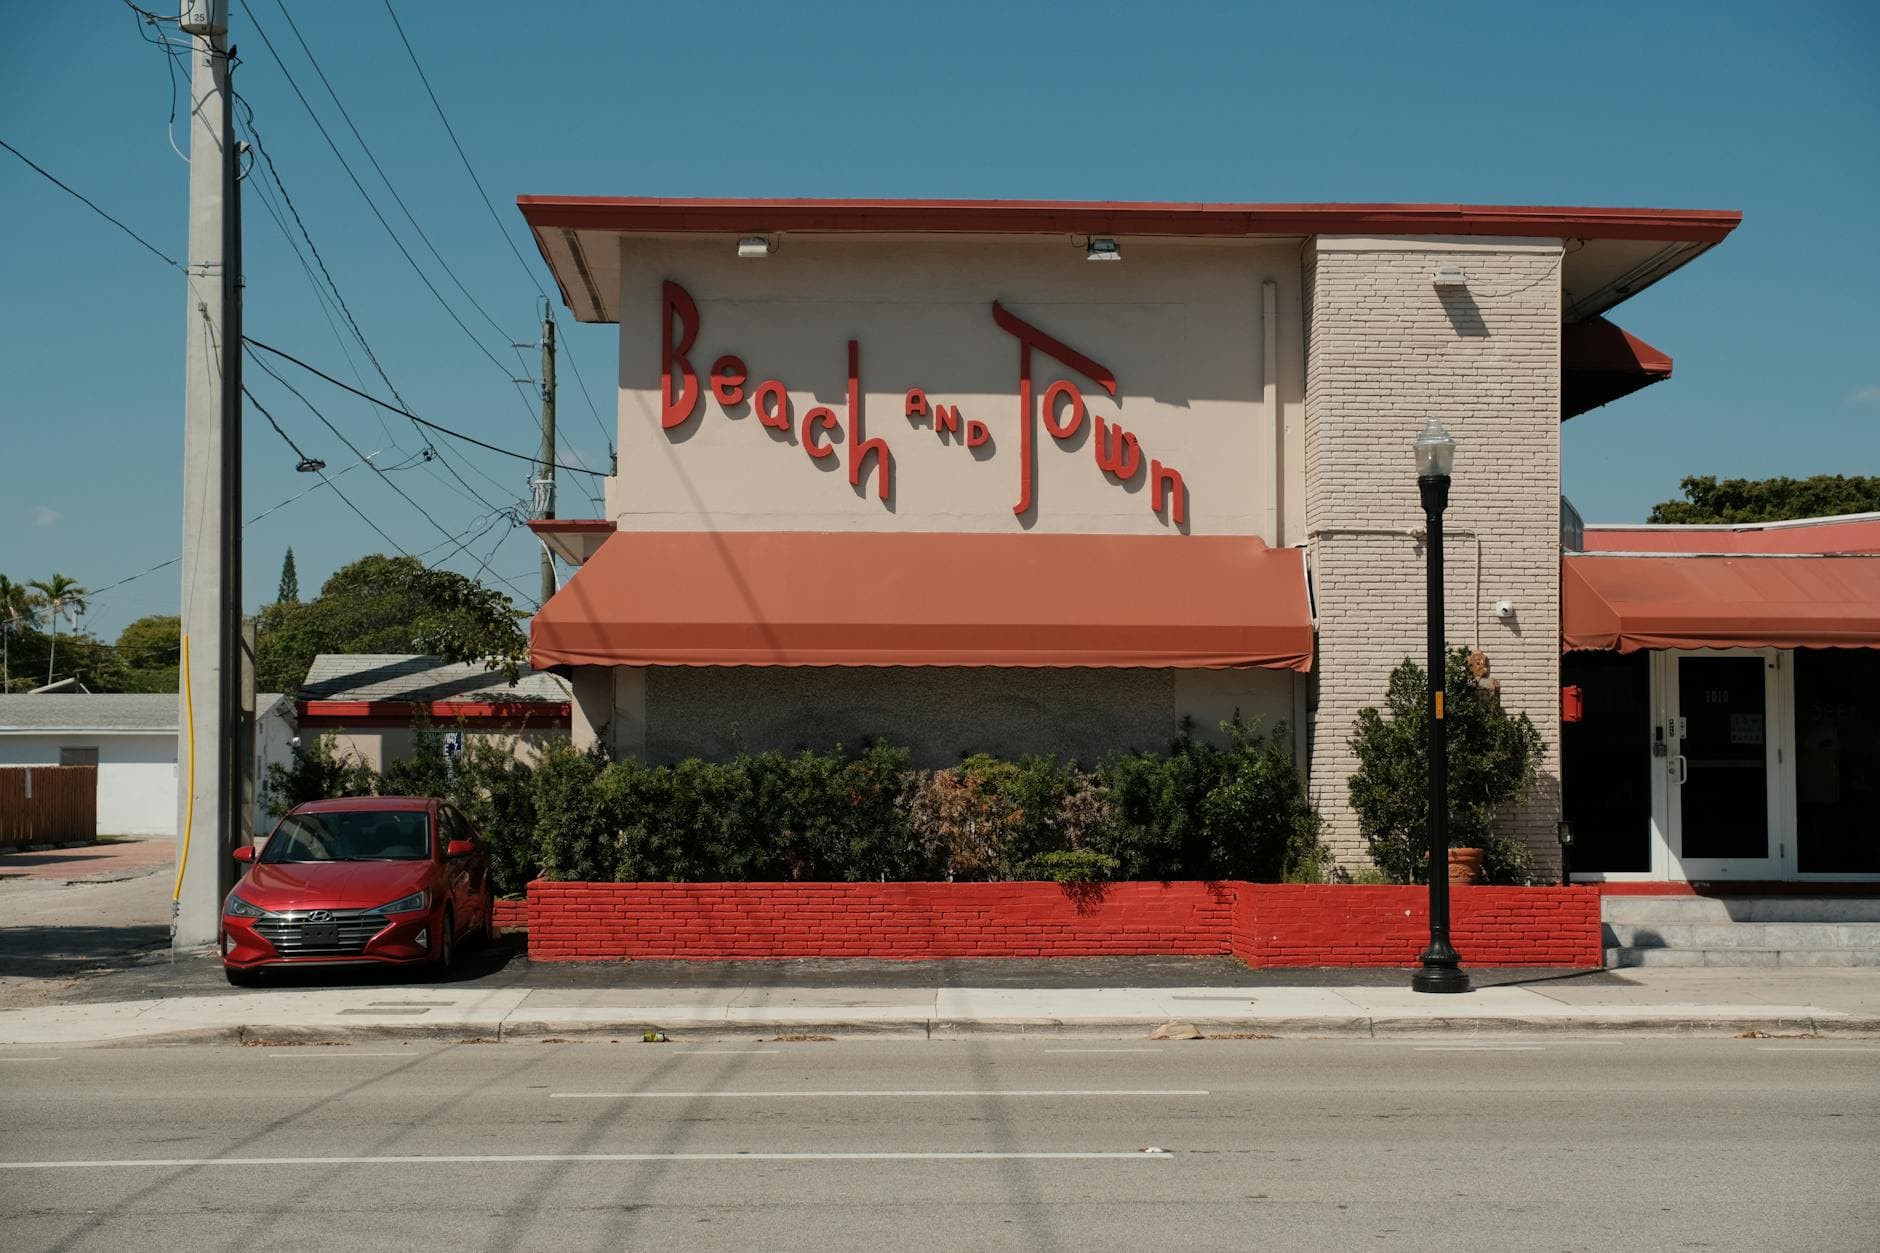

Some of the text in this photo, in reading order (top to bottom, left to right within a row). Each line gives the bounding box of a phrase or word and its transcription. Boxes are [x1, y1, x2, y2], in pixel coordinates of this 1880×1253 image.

[194, 14, 205, 22] 25
[661, 280, 1185, 525] Beach AND Town
